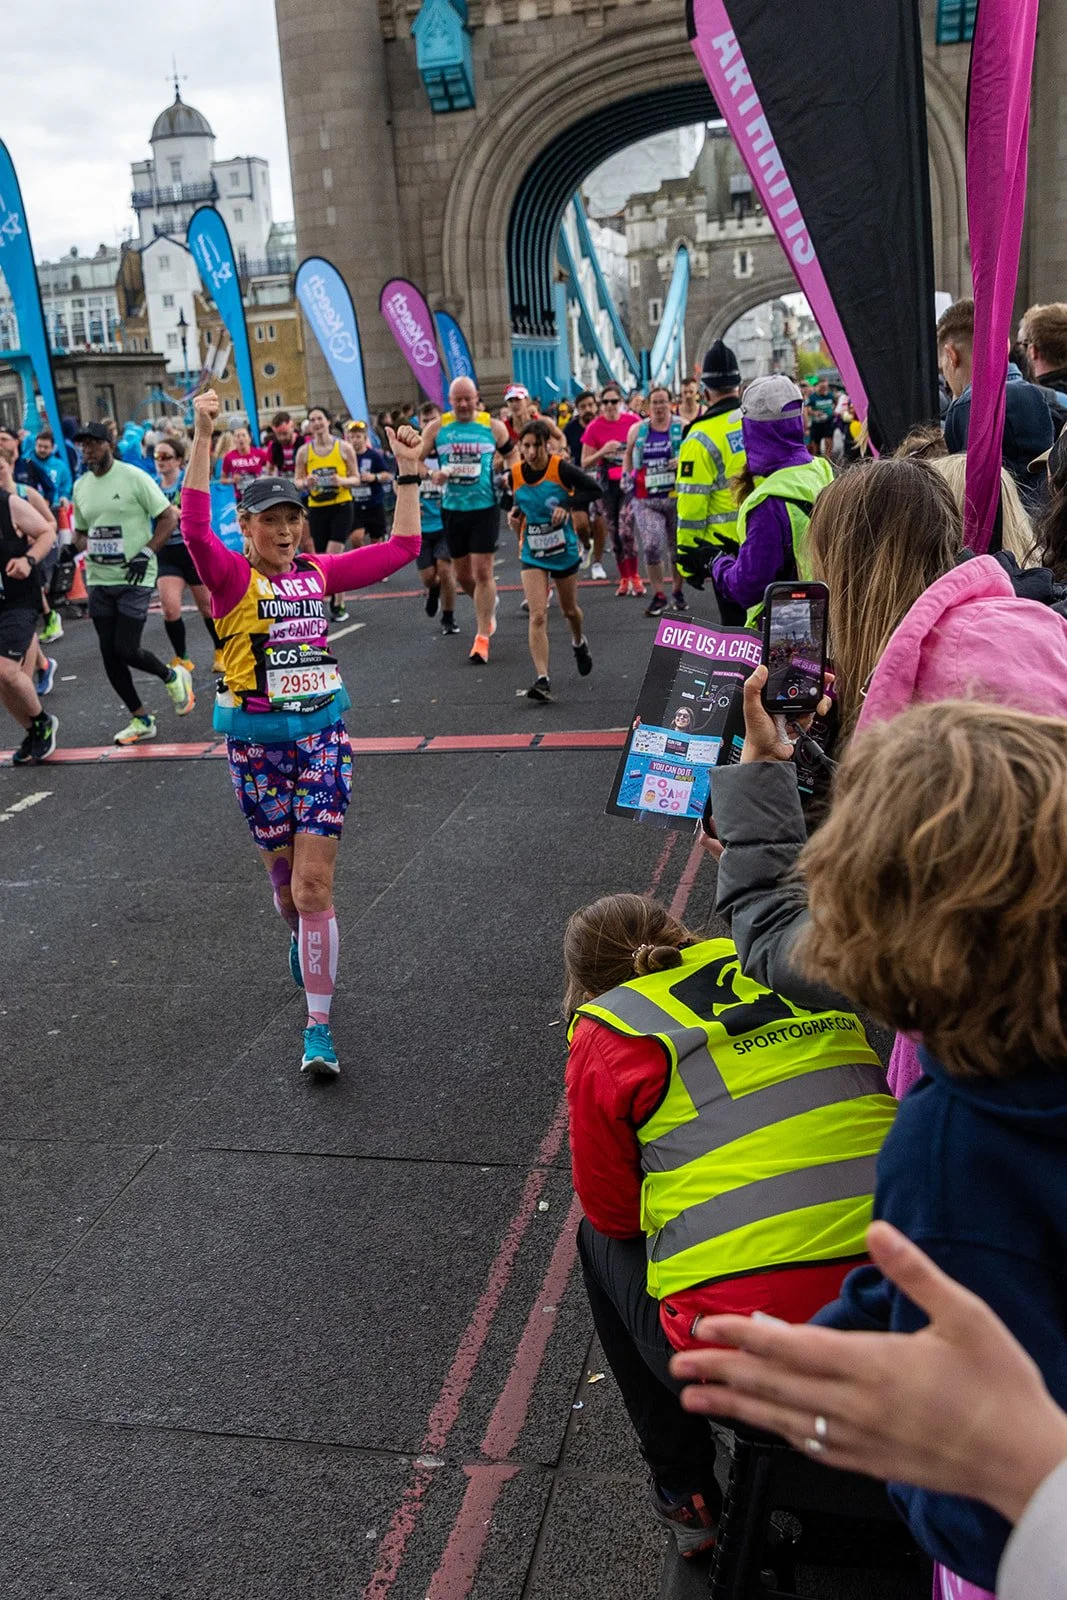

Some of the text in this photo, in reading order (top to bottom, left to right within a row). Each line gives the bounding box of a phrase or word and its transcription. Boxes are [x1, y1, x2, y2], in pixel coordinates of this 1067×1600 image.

[711, 30, 816, 265] ARTHRITIS
[452, 443, 481, 453] WILL
[256, 576, 322, 597] KAREN
[260, 601, 300, 618] YOUNG
[662, 626, 763, 665] GIVE US A CHEE
[281, 671, 327, 694] 29531
[652, 762, 664, 771] YOU
[664, 763, 677, 774] CAN
[676, 766, 686, 776] DO
[685, 768, 693, 776] IT
[308, 931, 321, 976] SKINS
[733, 1017, 859, 1055] SPORTOGRAF.COM
